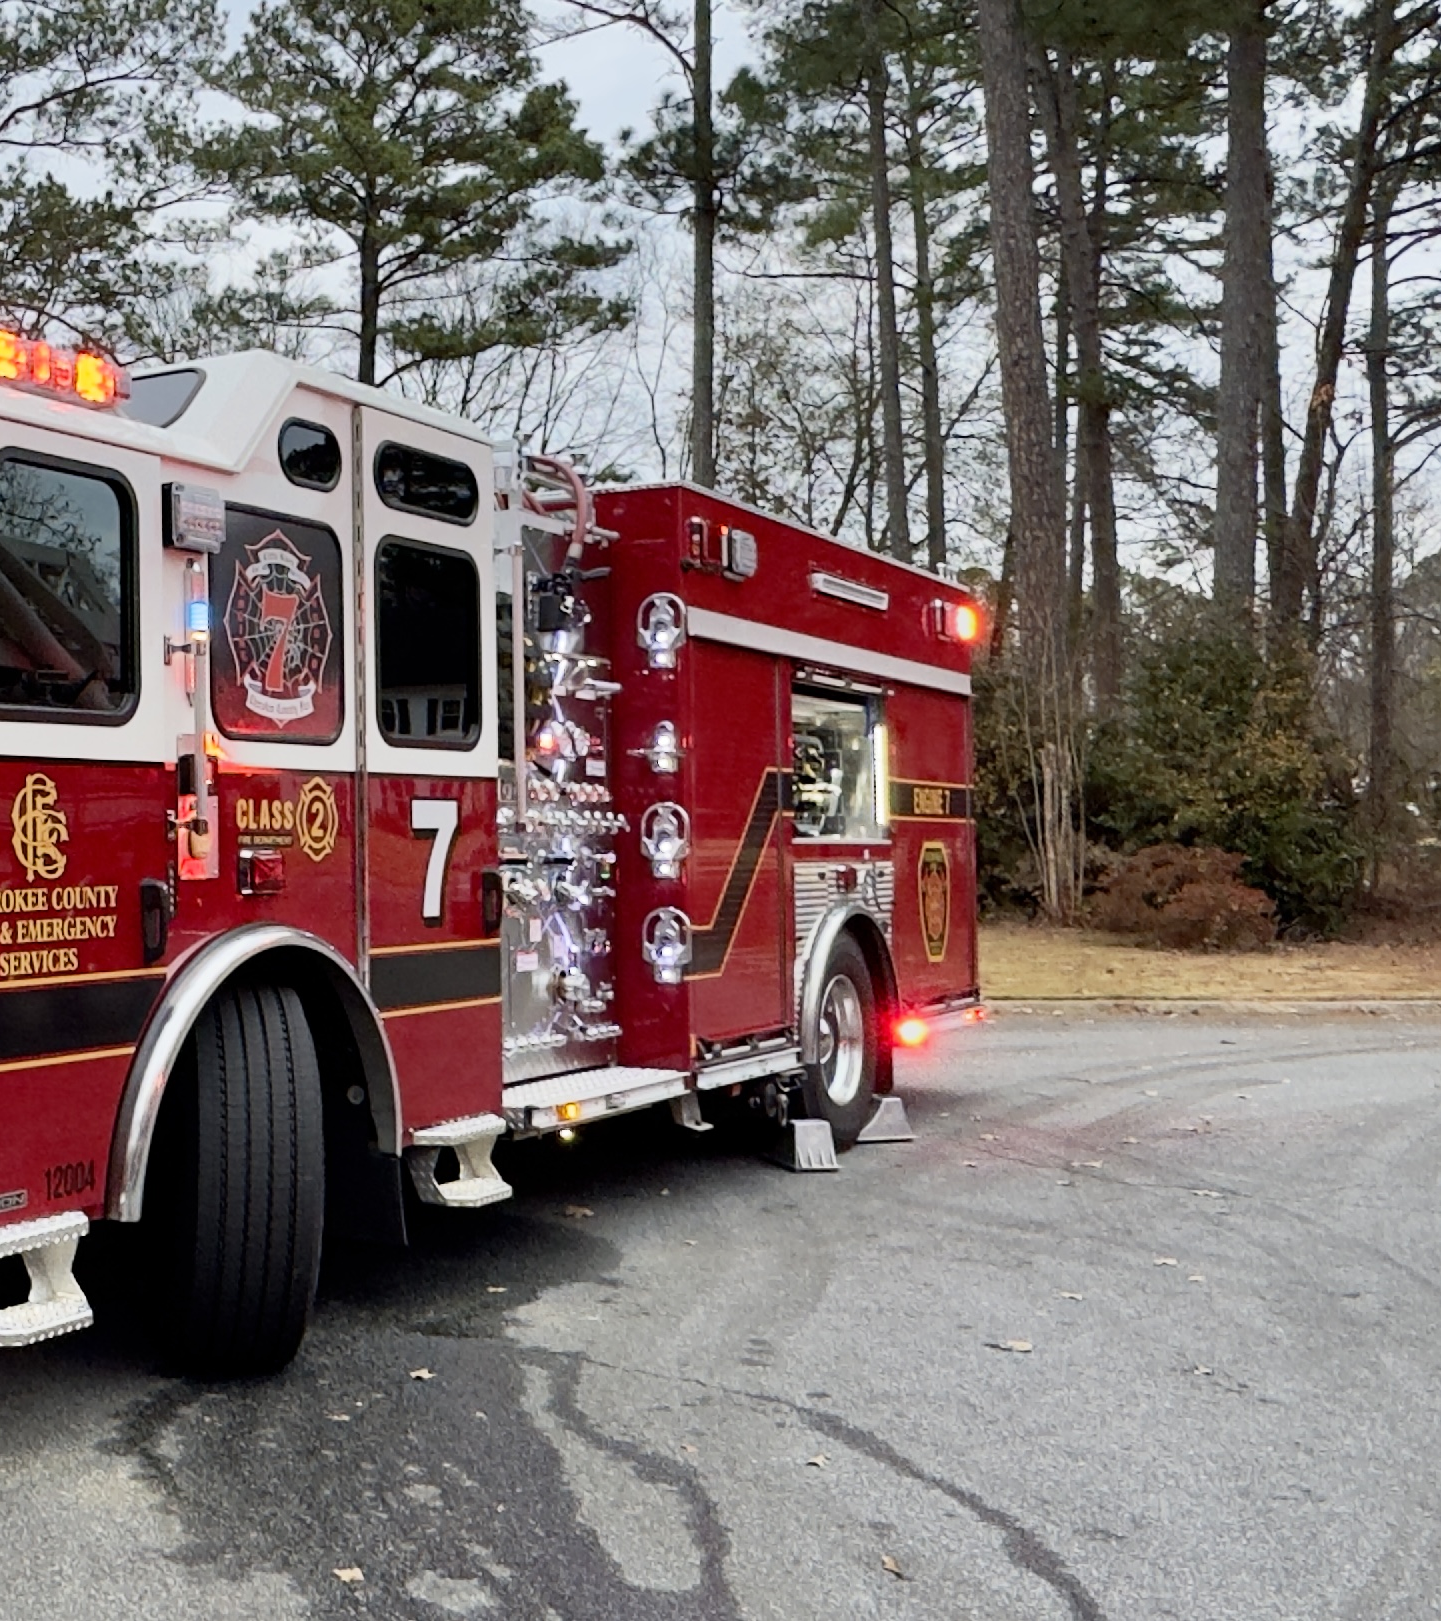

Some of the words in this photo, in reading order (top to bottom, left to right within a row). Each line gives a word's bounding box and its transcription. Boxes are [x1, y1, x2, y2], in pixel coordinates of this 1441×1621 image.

[260, 591, 299, 692] 7
[236, 798, 294, 831] CLASS
[310, 801, 326, 838] 2
[411, 799, 459, 918] 7
[51, 885, 119, 911] COUNTY
[0, 921, 13, 945] &
[16, 915, 118, 944] EMERGENCY
[0, 948, 79, 976] SERVICES
[44, 1160, 96, 1201] 12004
